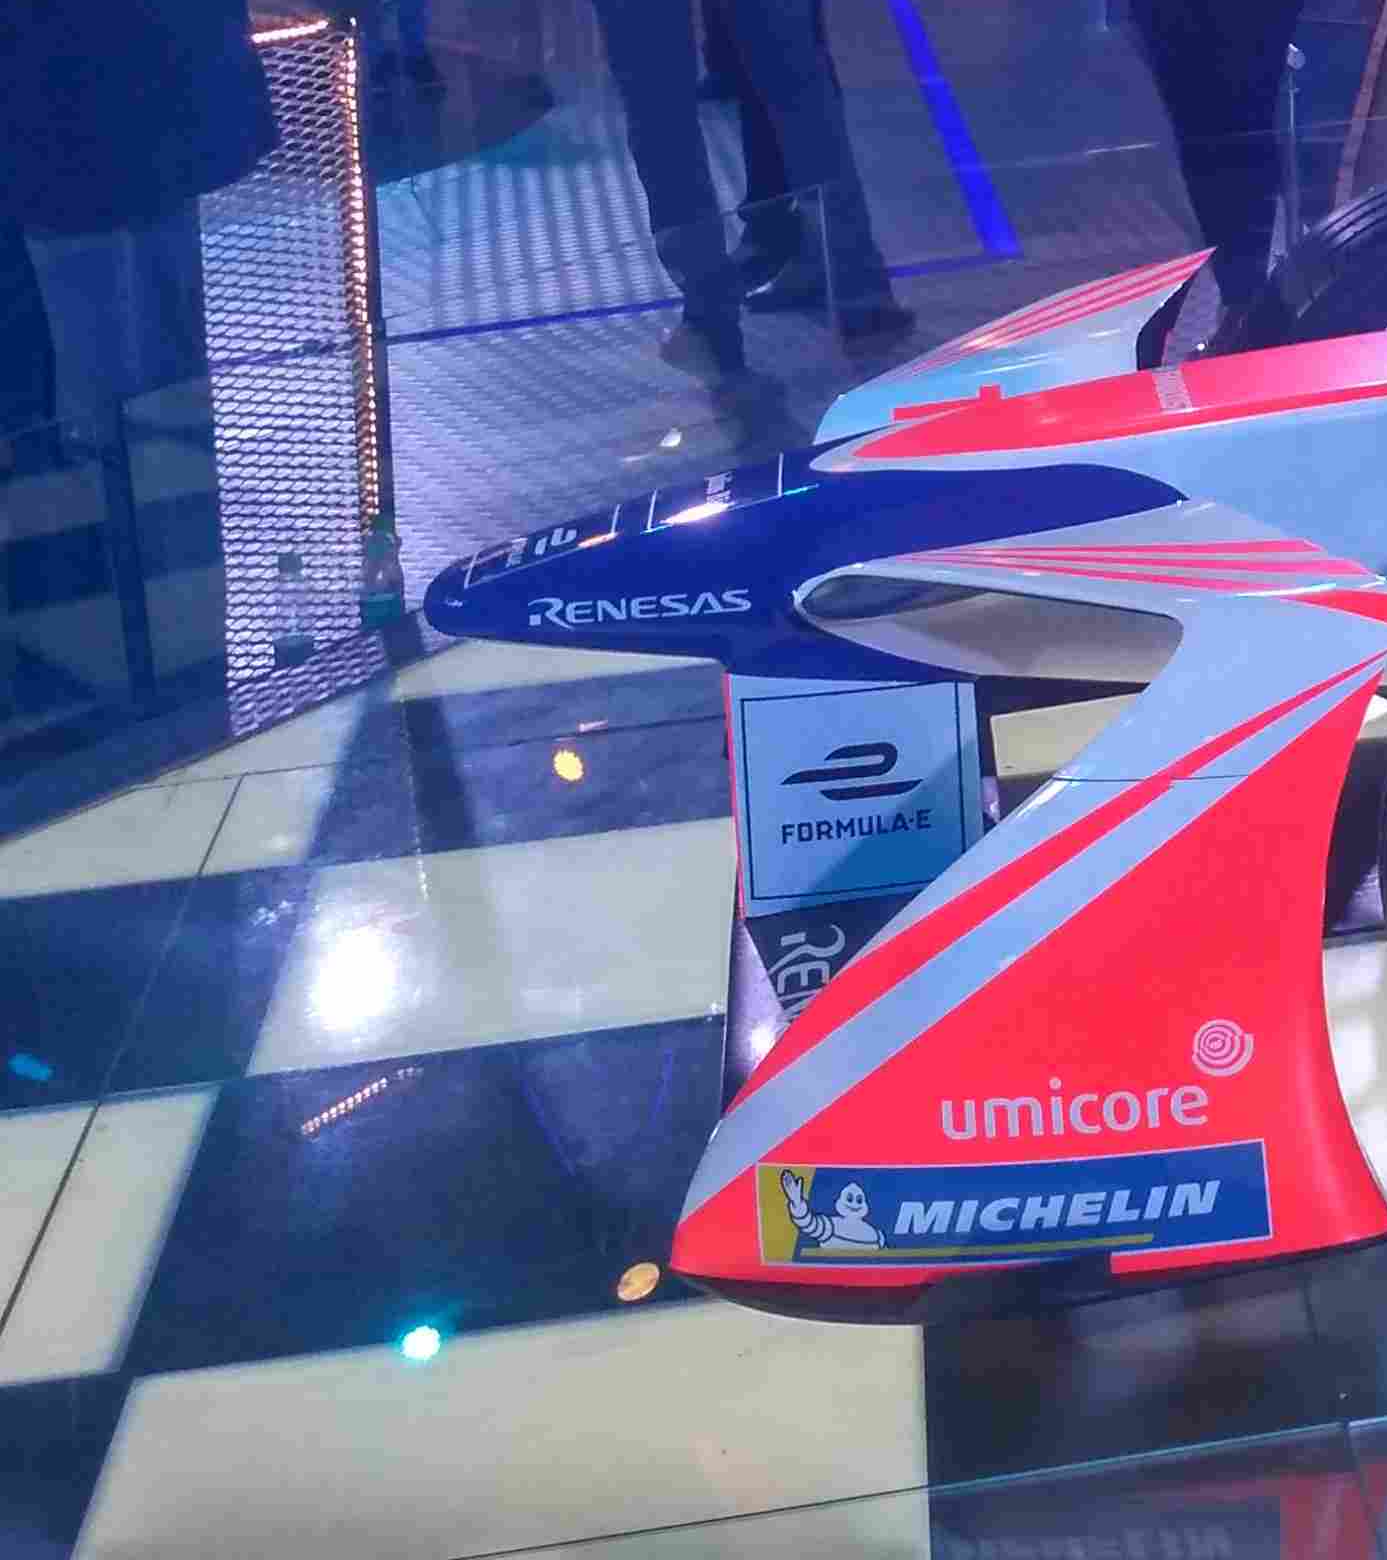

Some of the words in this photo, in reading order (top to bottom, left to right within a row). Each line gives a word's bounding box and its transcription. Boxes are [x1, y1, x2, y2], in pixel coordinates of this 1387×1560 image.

[528, 589, 752, 630] RENESAS
[941, 1077, 1210, 1141] umicore
[894, 1180, 1220, 1236] MICHELIN
